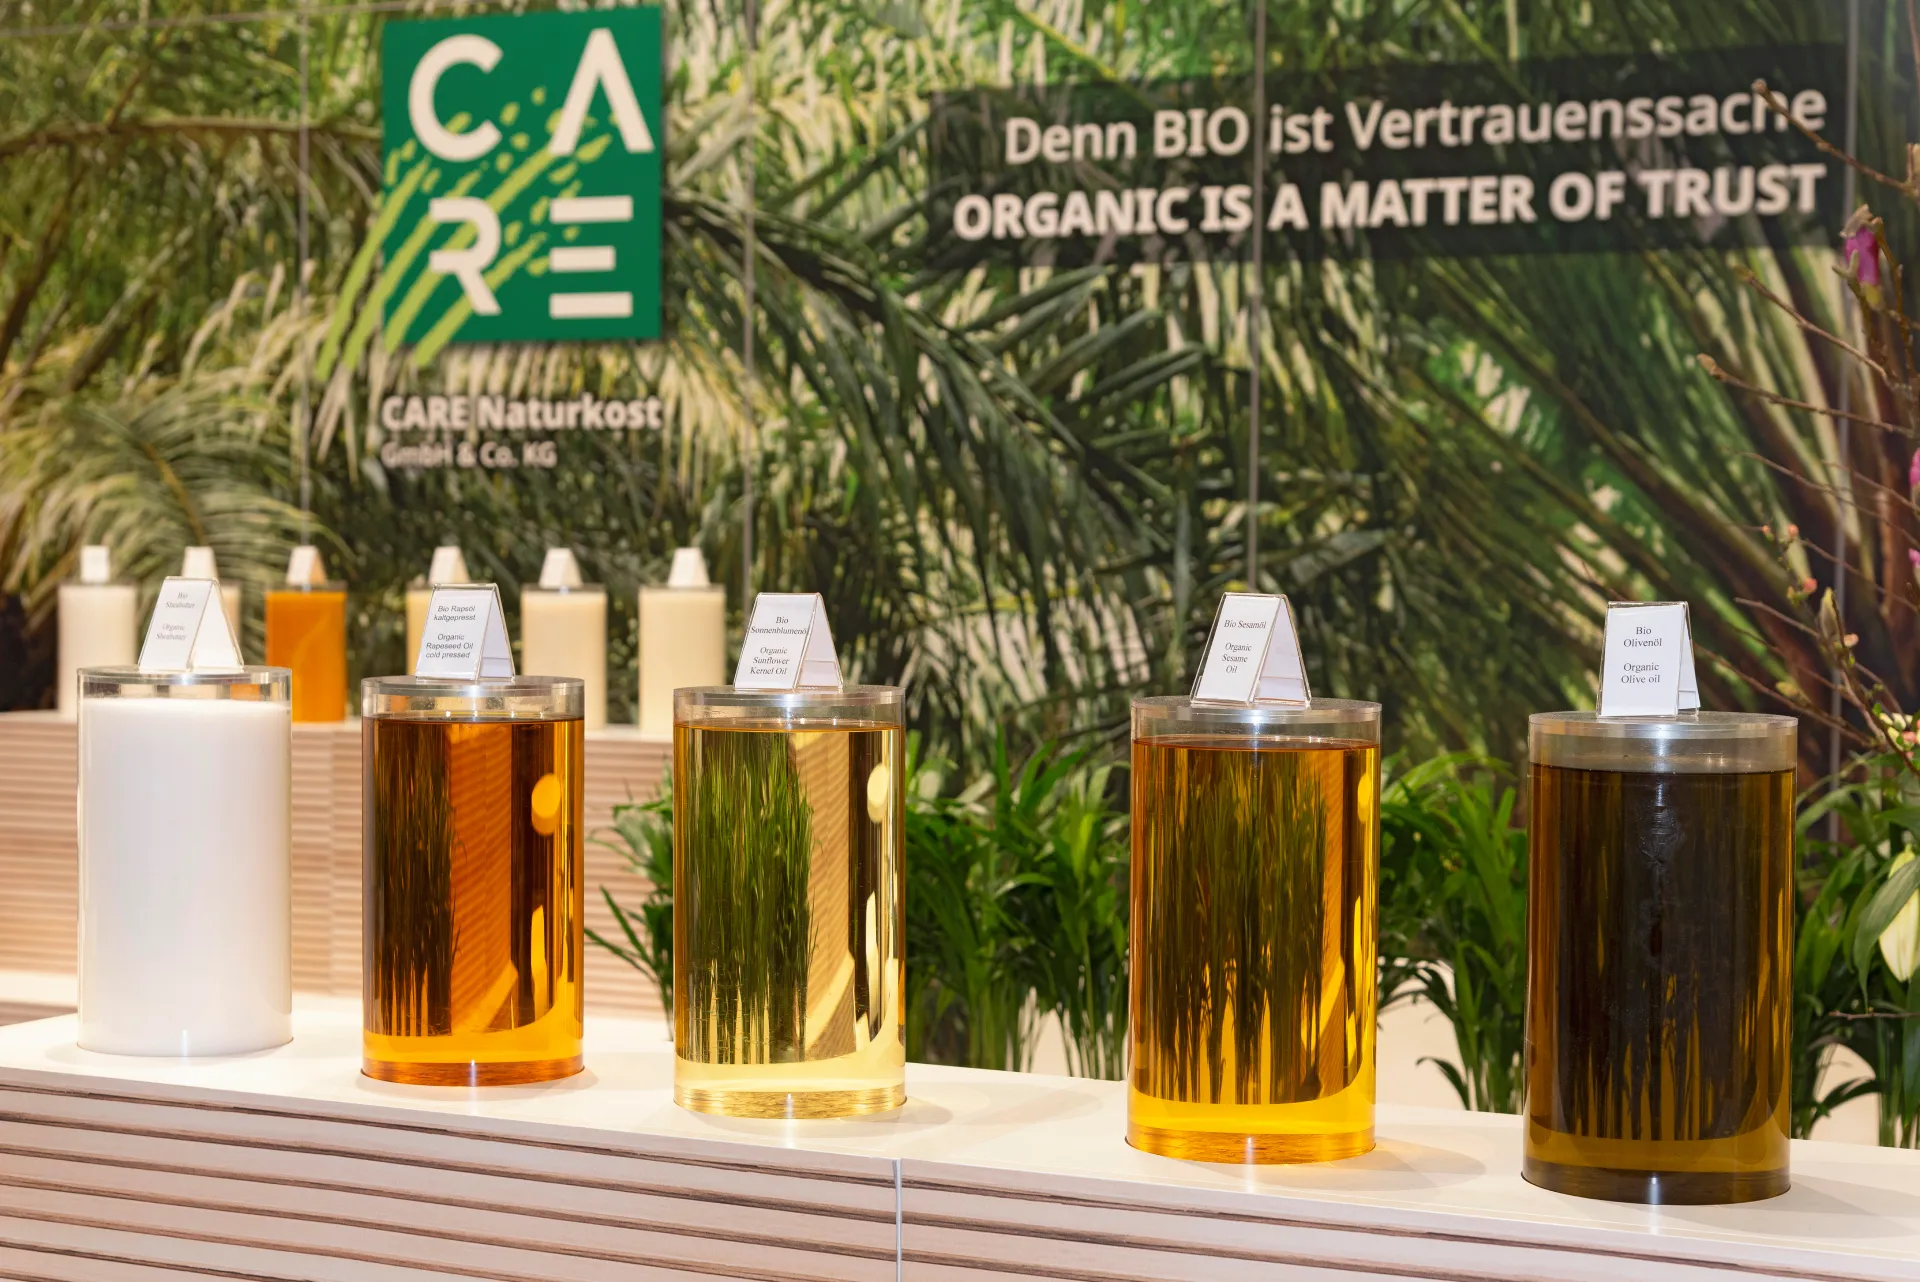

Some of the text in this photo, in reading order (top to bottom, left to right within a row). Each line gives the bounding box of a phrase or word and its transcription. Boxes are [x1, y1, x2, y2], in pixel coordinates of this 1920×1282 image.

[1006, 87, 1827, 165] Denn BIO ist Vertrauenssache
[953, 164, 1827, 241] ORGANIC IS A MATTER OF TRUST
[381, 394, 663, 430] CARE Naturkost
[380, 441, 557, 468] GmbH & Co. KG
[434, 614, 475, 622] kaltgepresst
[1636, 627, 1652, 635] Bio
[1624, 638, 1662, 647] Olivenöl
[760, 647, 787, 655] Organic
[1225, 643, 1252, 652] Organic
[1222, 654, 1248, 662] Sesame
[1624, 663, 1659, 673] Organic
[1621, 675, 1660, 683] Olive oil
